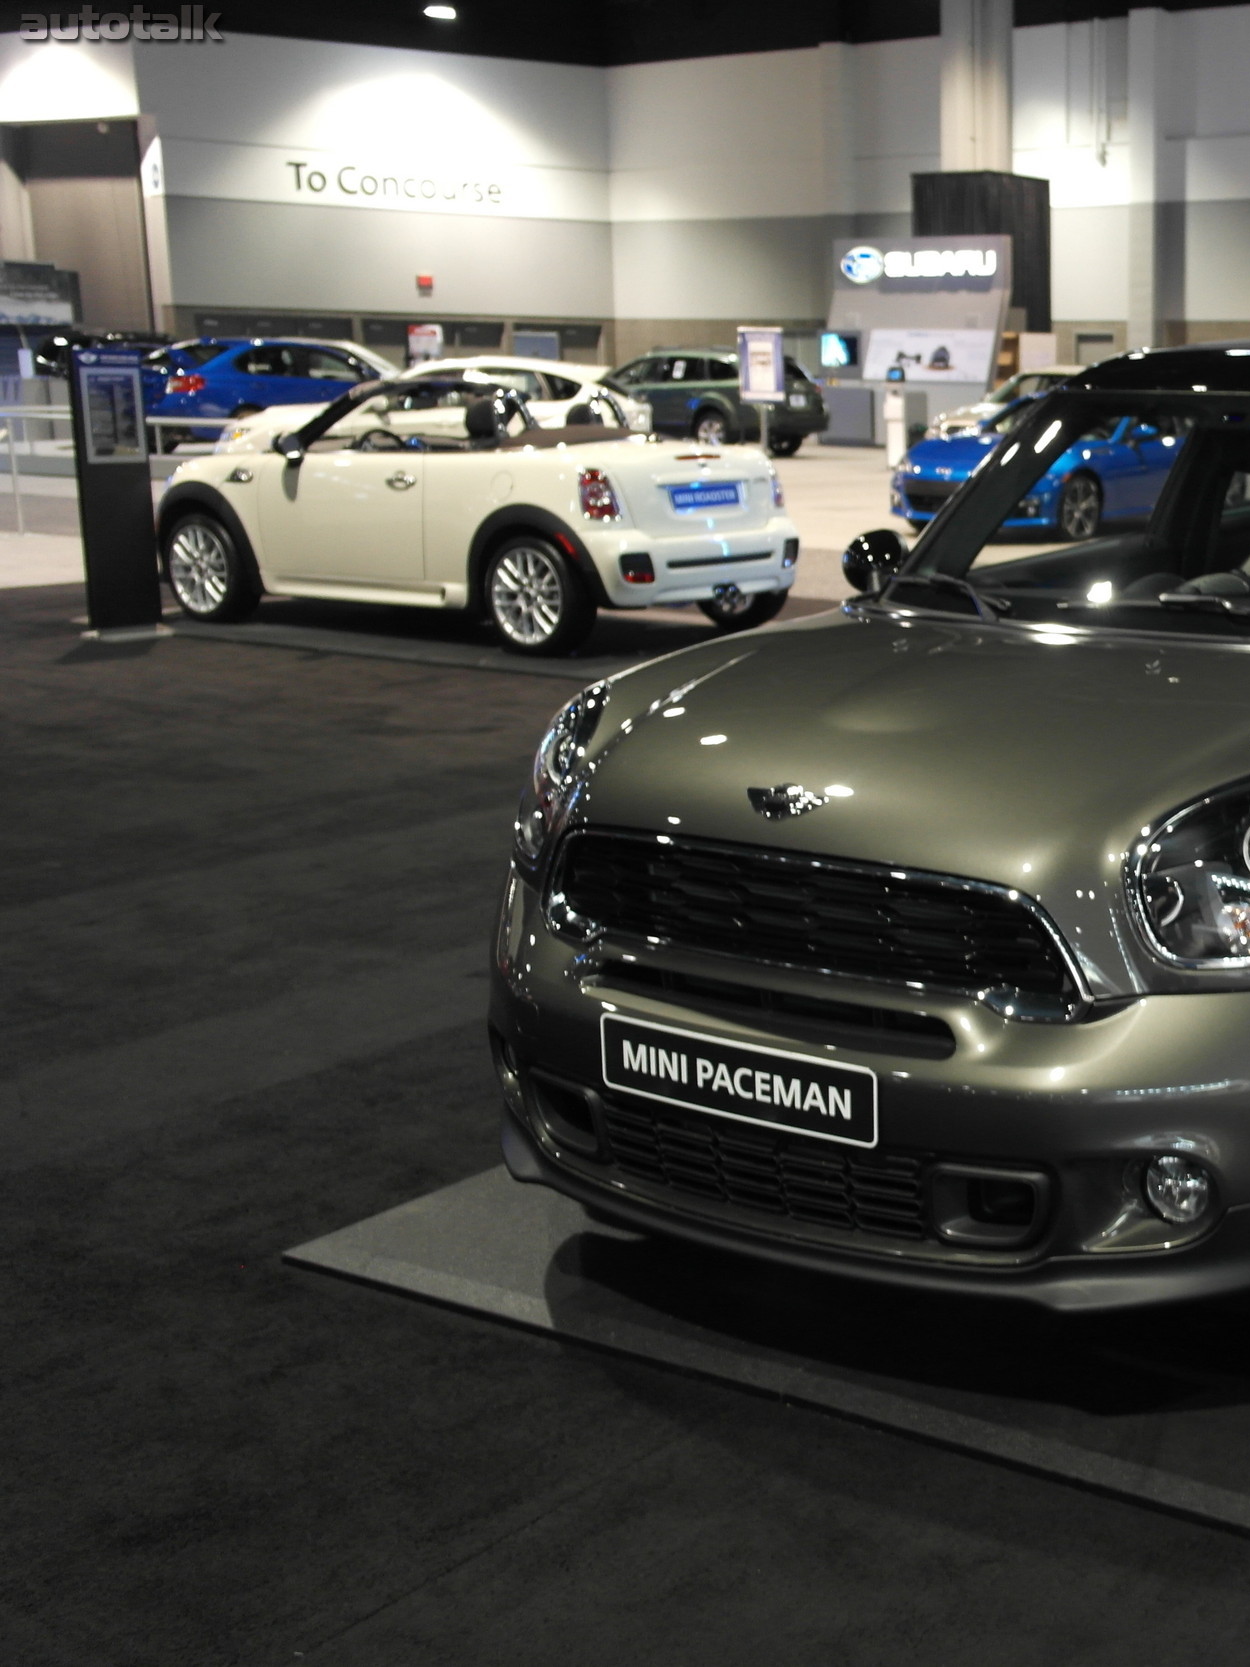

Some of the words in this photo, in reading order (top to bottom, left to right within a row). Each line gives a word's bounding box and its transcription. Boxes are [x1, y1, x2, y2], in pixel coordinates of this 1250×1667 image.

[286, 161, 327, 193] To
[621, 1039, 689, 1085] MINI
[696, 1058, 851, 1120] PACEMAN
